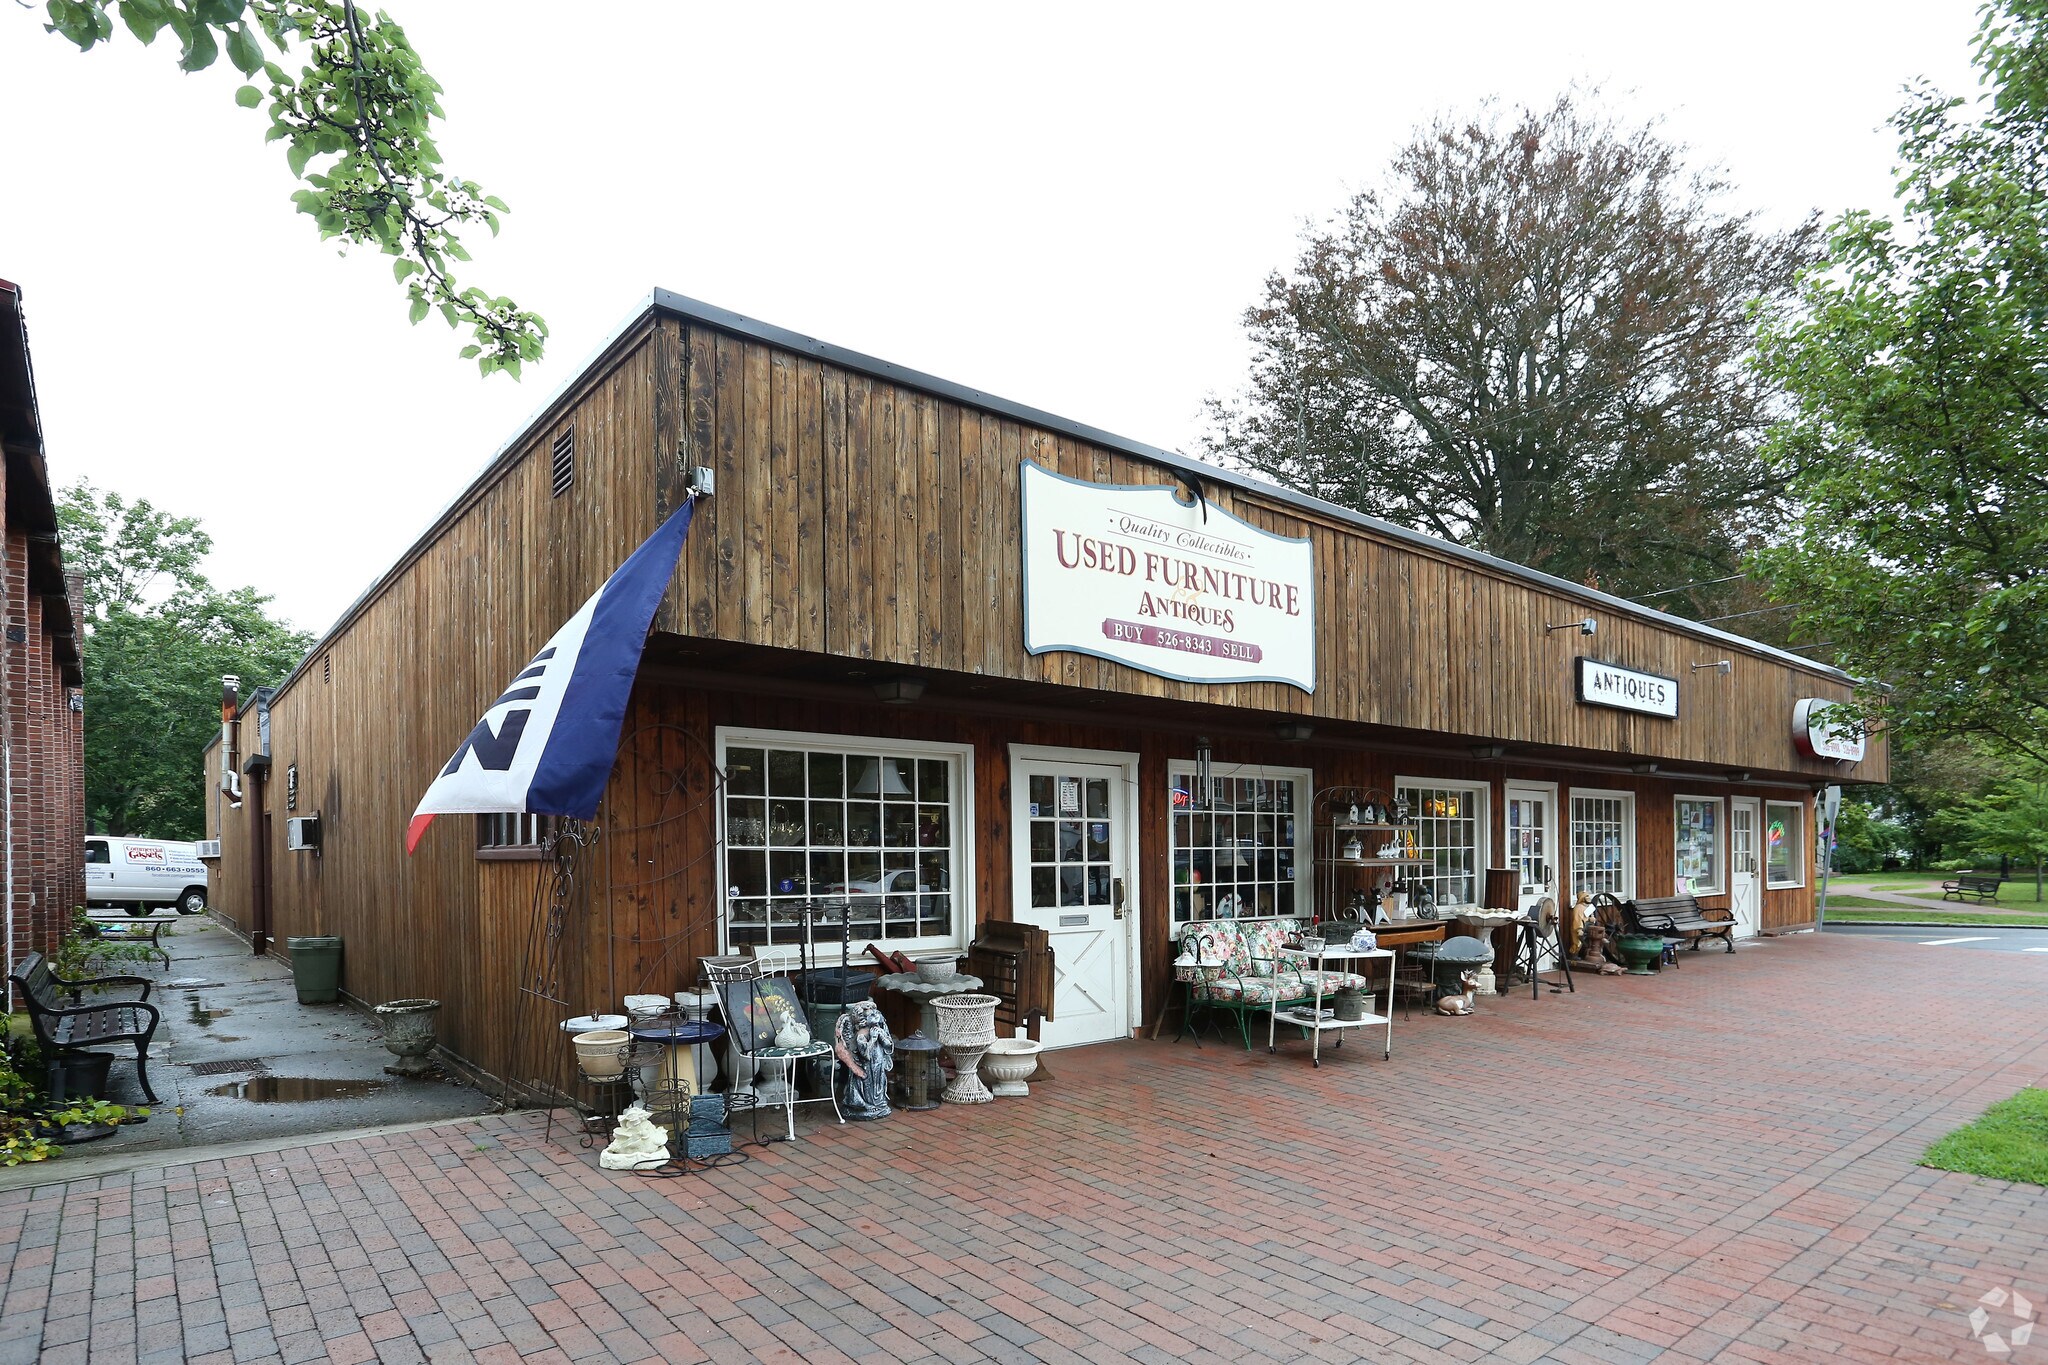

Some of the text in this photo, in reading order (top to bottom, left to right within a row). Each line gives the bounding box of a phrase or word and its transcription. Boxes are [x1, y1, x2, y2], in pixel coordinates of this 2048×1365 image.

[1119, 516, 1245, 560] Quality Collectibles
[1052, 528, 1300, 617] USED FURNITURE
[1137, 591, 1235, 633] ANTIQUES
[1113, 623, 1254, 660] BUY 526-8343 SELL
[1594, 670, 1665, 703] ANTIQUES
